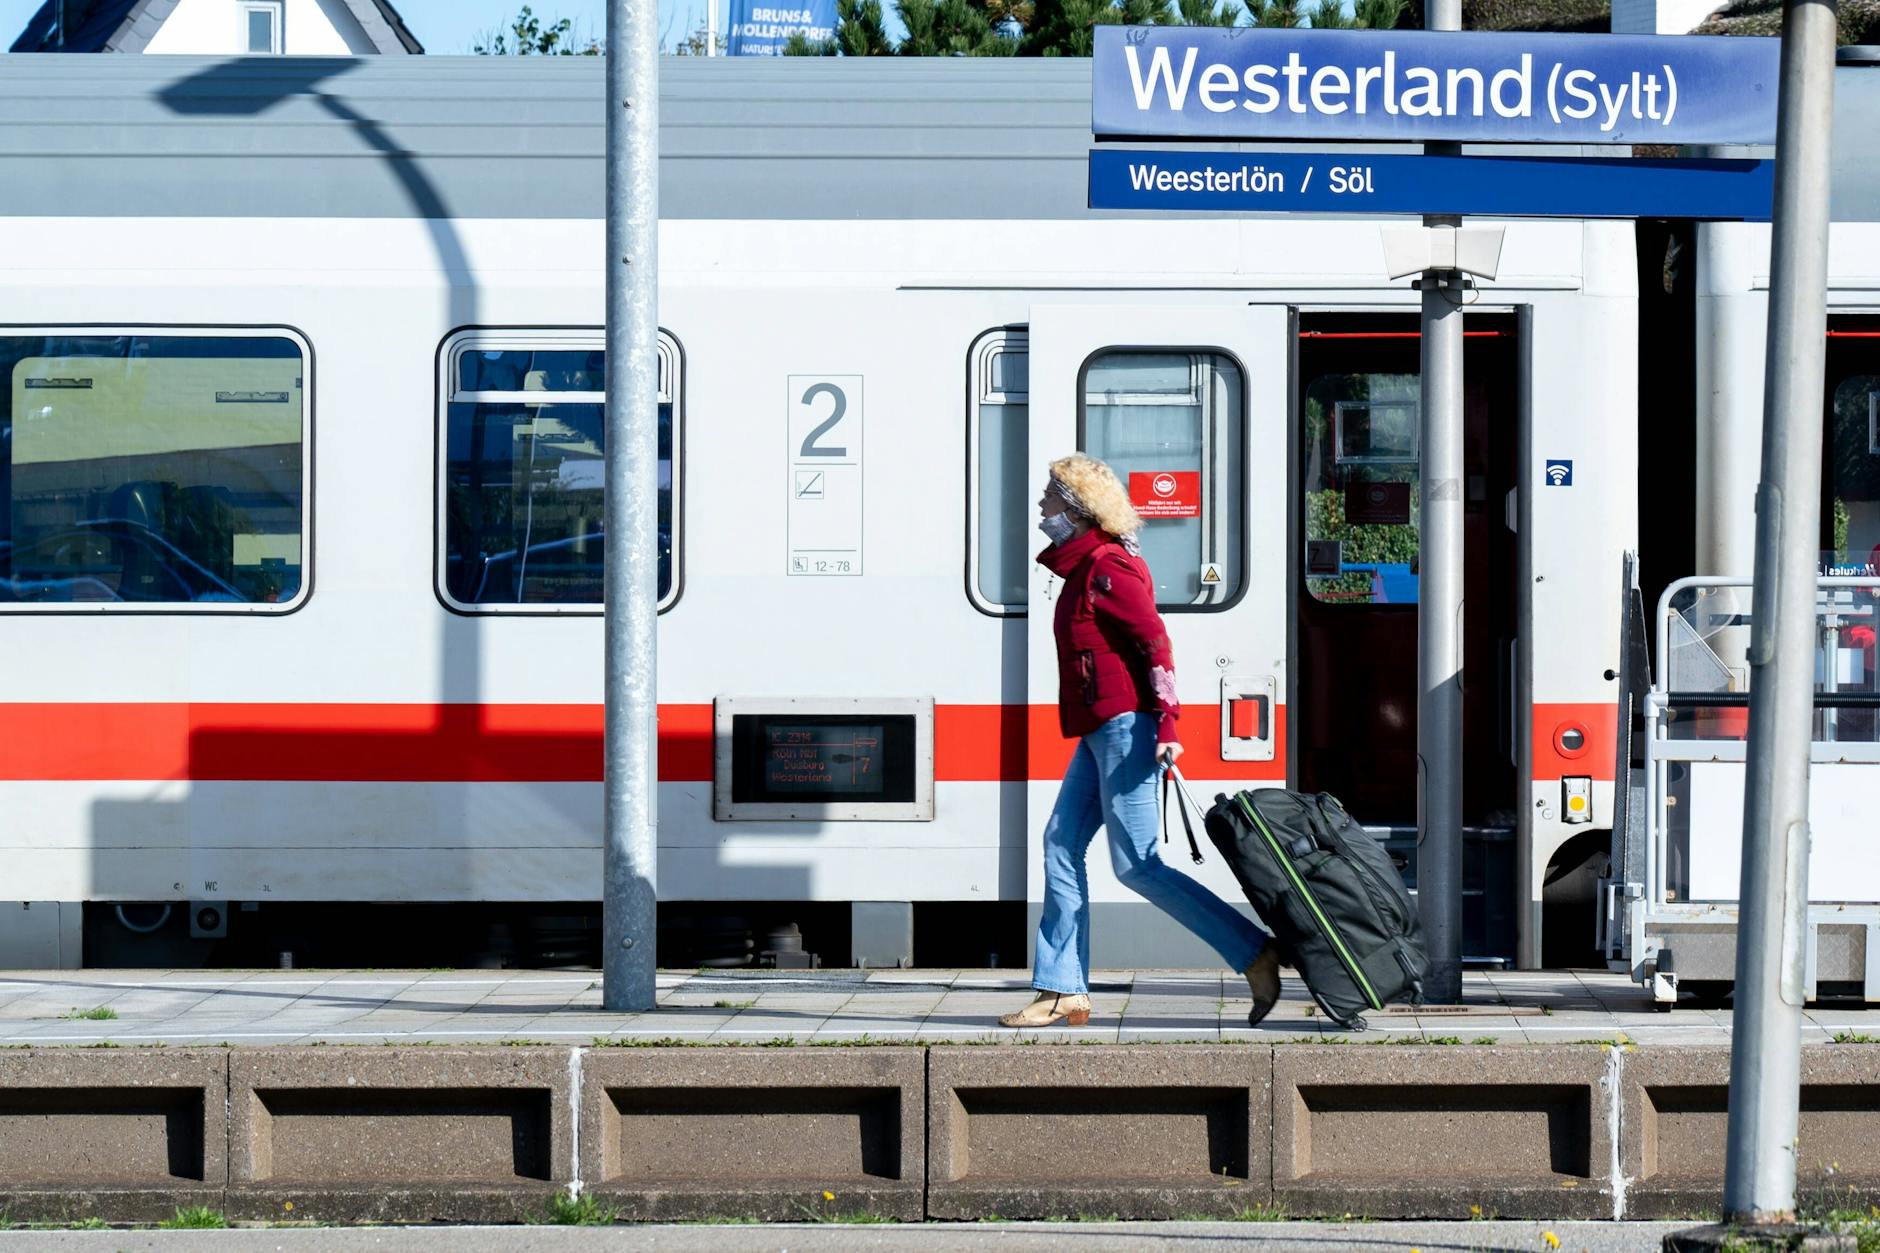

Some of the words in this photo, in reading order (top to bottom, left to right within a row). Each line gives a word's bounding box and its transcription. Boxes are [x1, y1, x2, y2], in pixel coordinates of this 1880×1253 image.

[1124, 45, 1533, 118] Westerland
[1547, 62, 1678, 131] (Sylt)
[1128, 164, 1284, 193] Weesterlön
[1300, 166, 1314, 193] /
[1328, 166, 1374, 194] Söl
[800, 382, 847, 457] 2
[204, 880, 218, 892] WC
